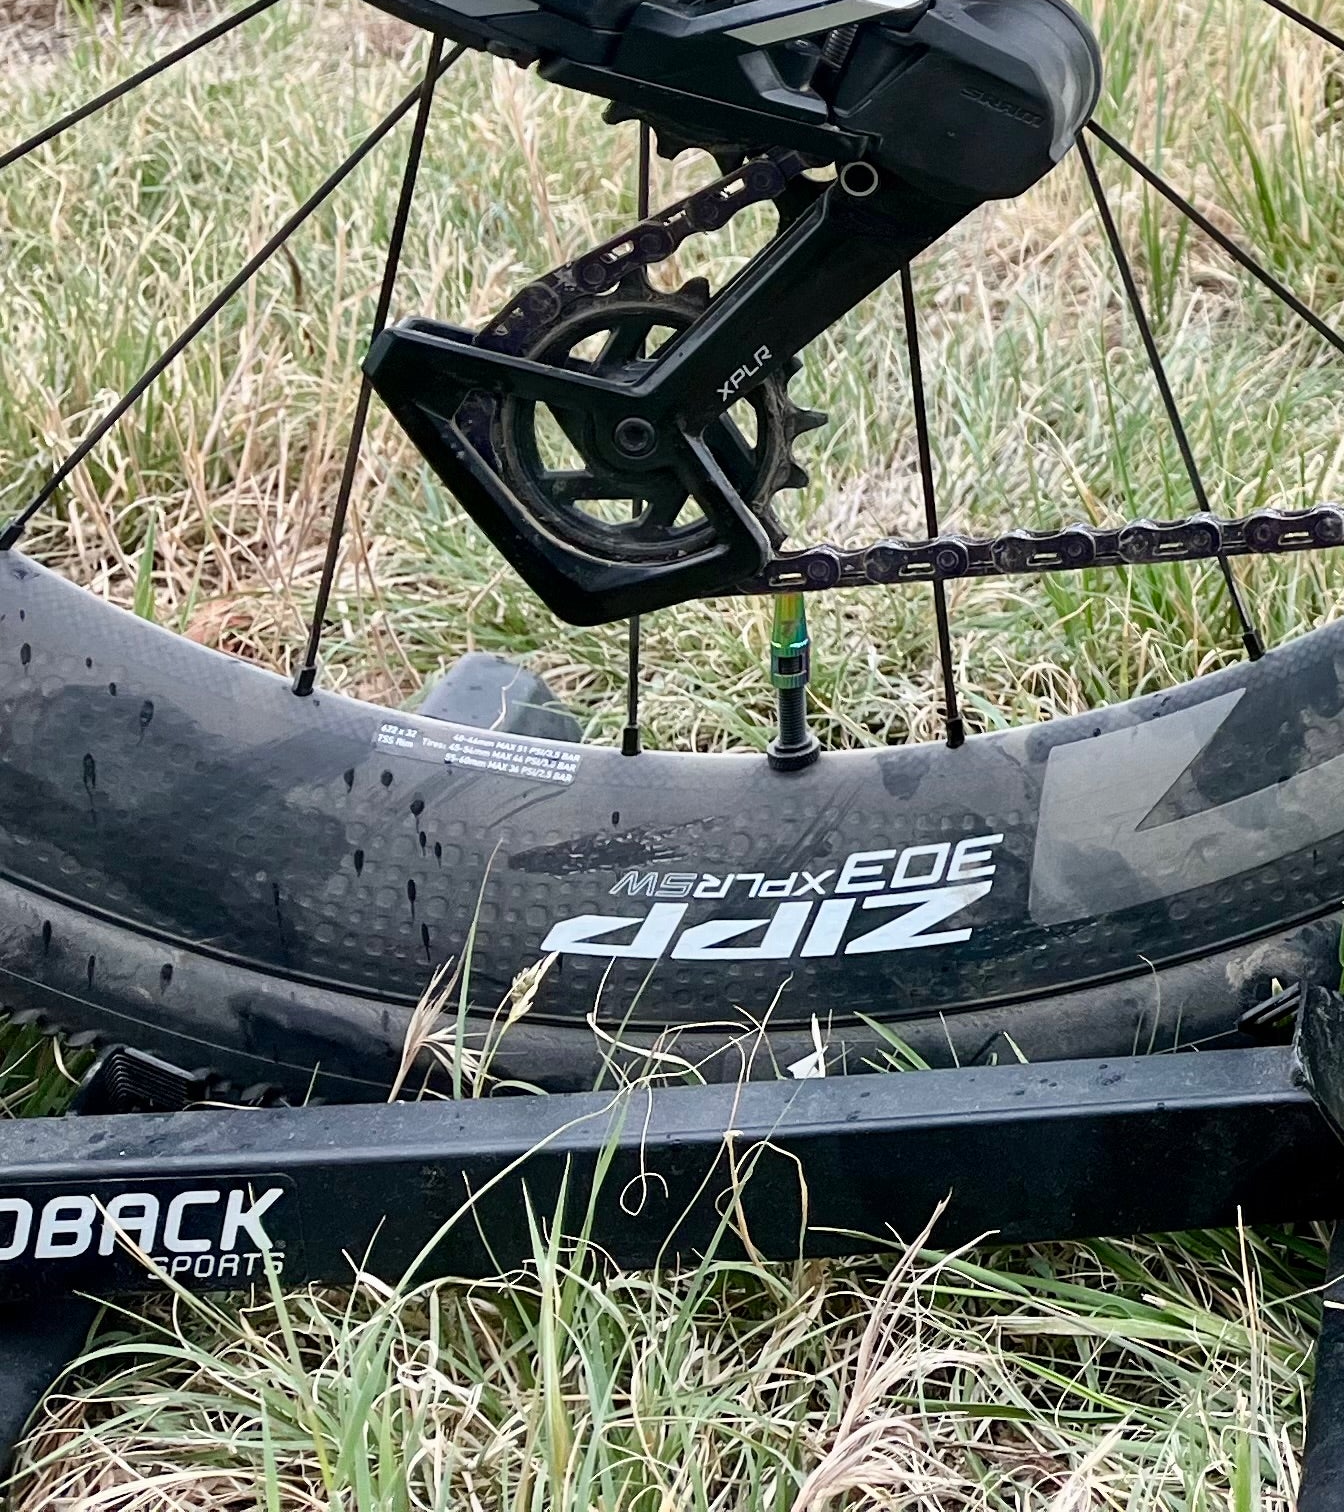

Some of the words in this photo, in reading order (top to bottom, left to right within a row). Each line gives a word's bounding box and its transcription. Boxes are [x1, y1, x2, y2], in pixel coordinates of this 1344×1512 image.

[716, 344, 773, 402] XPLR
[491, 749, 513, 761] MAX
[557, 760, 577, 772] BAR
[496, 740, 517, 752] MAX
[561, 751, 581, 763] BAR
[487, 759, 508, 772] MAX
[552, 770, 573, 783] BAR
[835, 833, 1004, 894] 303
[539, 880, 993, 960] ZIPP
[148, 1251, 285, 1280] SPORTS
